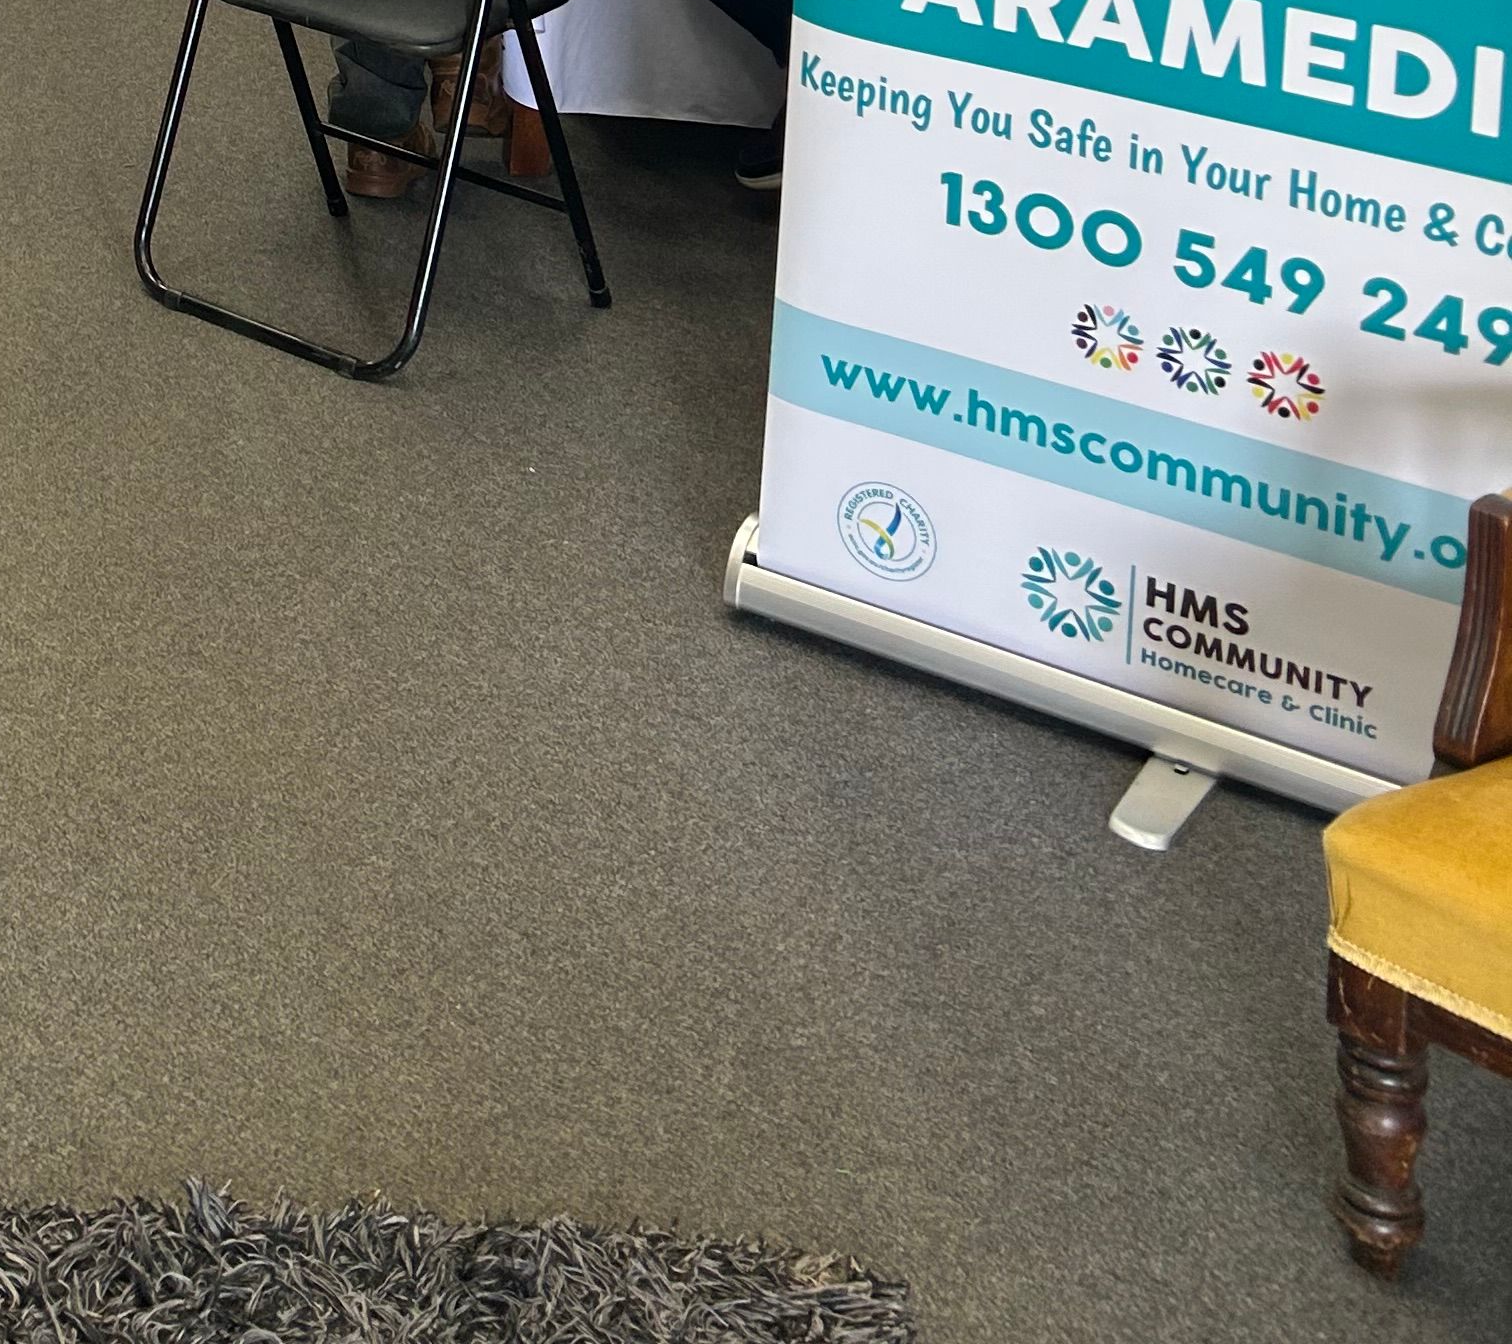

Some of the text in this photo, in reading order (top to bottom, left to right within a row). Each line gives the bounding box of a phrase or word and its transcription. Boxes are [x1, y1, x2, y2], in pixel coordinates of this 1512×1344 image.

[800, 51, 932, 132] Keeping
[948, 90, 1014, 142] You
[1027, 109, 1112, 162] Safe
[1129, 134, 1163, 176] in
[1180, 144, 1271, 202] Your
[1287, 169, 1406, 233] Home
[1423, 202, 1459, 247] &
[940, 171, 1512, 366] 1300 549 249
[844, 489, 930, 547] REGISTERED CHARITY
[1146, 575, 1249, 636] HMS
[1141, 647, 1377, 740] Homecare & Clinic
[1143, 617, 1373, 708] COMMUNITY
